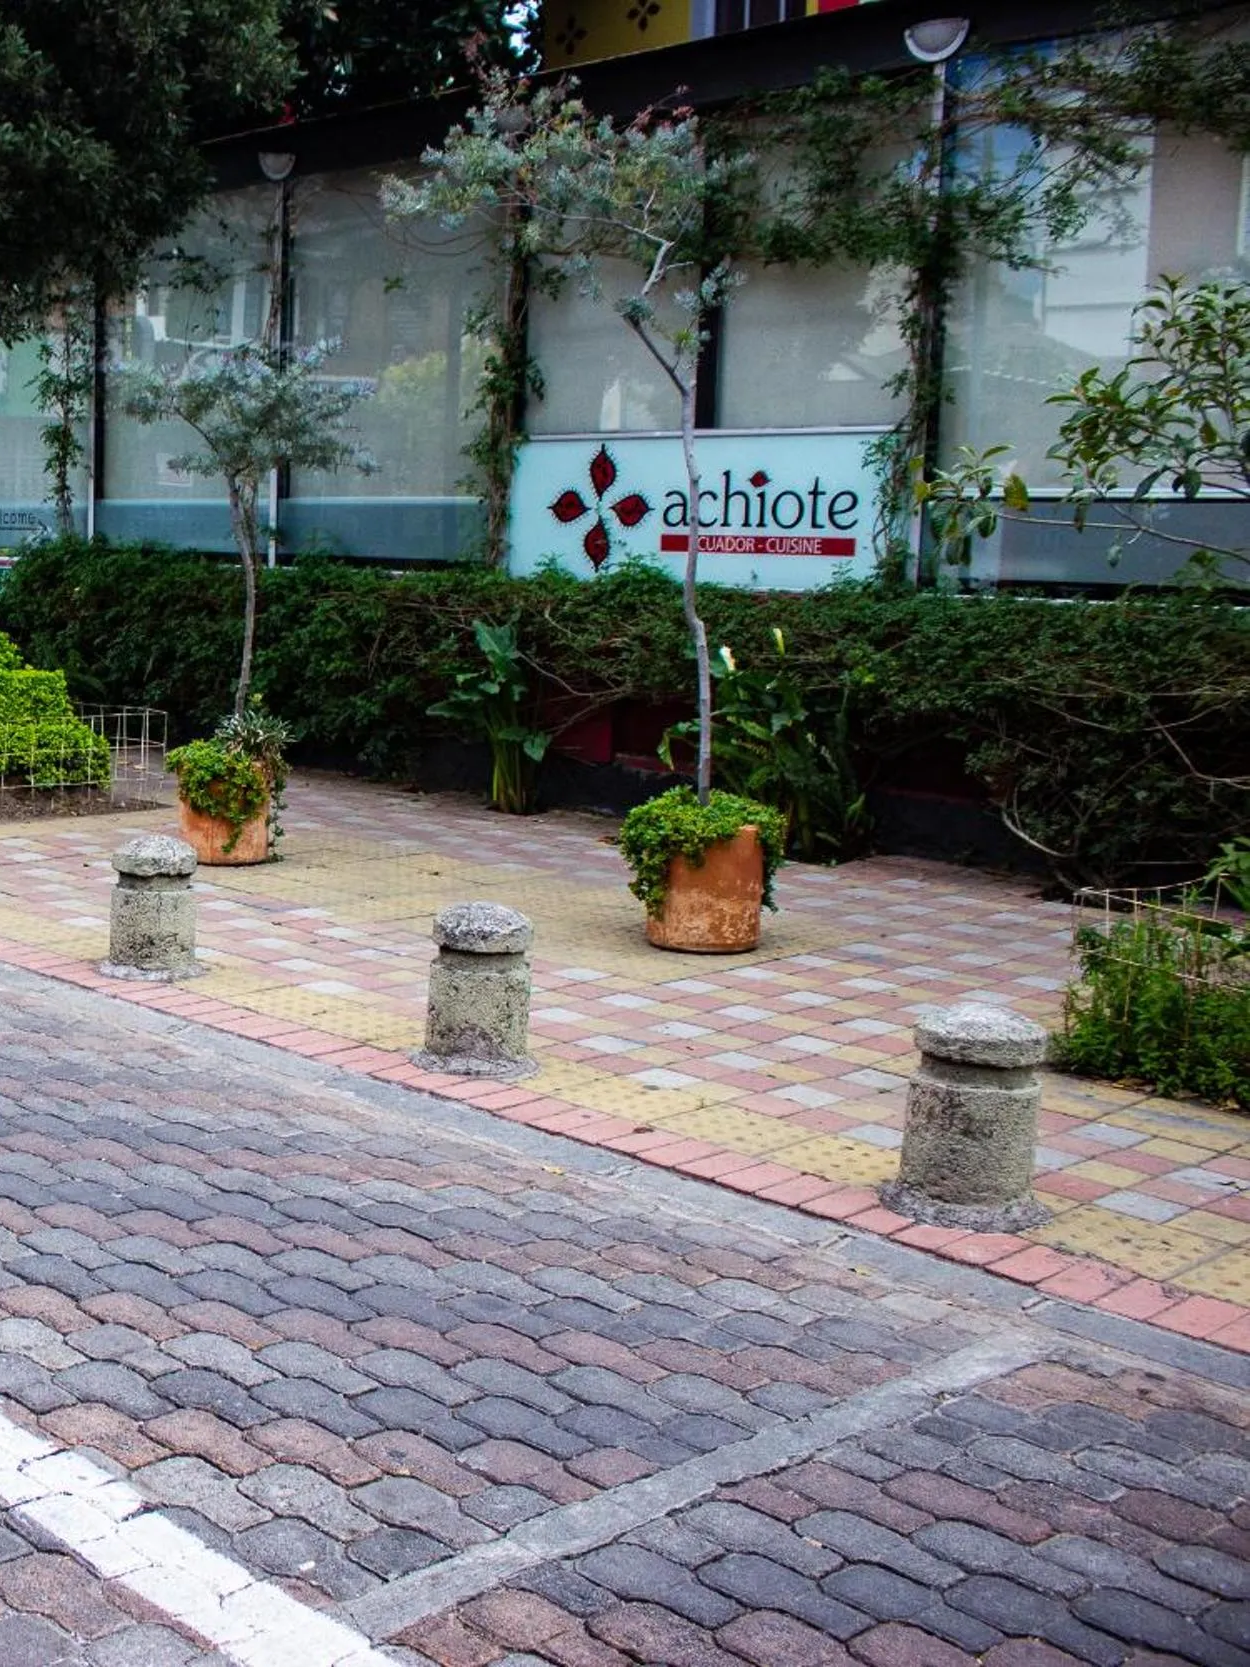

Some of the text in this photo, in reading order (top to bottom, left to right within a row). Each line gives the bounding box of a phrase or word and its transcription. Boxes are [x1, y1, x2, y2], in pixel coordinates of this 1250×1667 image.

[662, 469, 859, 530] achiote
[696, 536, 755, 552] CUADOR
[765, 537, 823, 554] CUISINE
